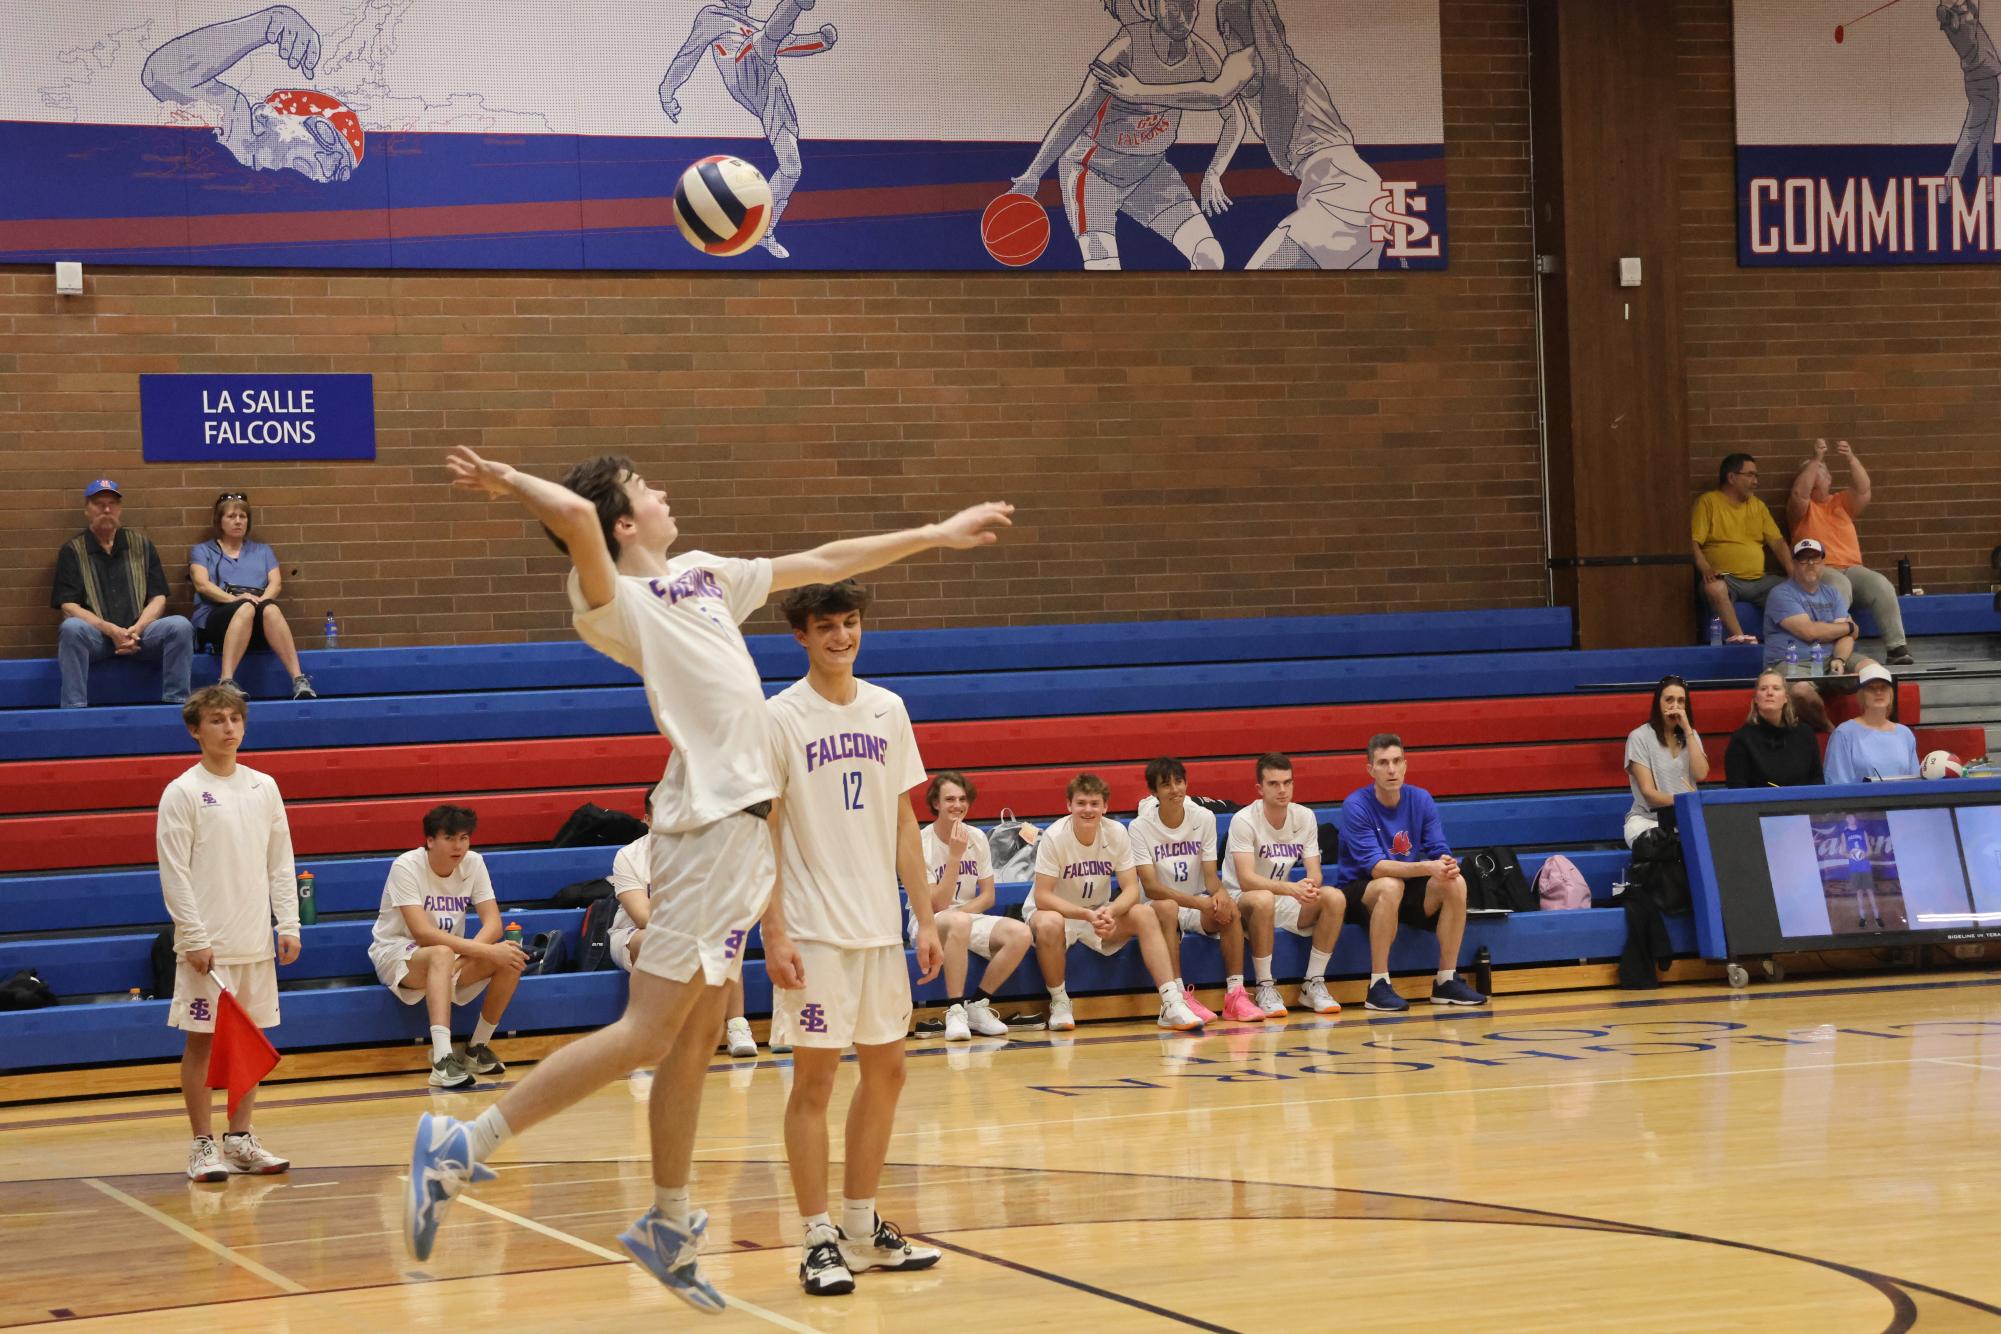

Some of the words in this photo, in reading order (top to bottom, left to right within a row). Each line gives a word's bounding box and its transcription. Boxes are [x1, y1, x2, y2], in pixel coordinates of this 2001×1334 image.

[202, 390, 236, 413] LA
[241, 389, 315, 413] SALLE
[204, 420, 316, 444] FALCONS
[805, 732, 888, 773] FALCONS
[842, 771, 864, 811] 12
[1154, 840, 1202, 862] FALCONS
[1062, 860, 1113, 879] FALCONS
[1173, 861, 1189, 882] 13
[1081, 881, 1094, 899] 11
